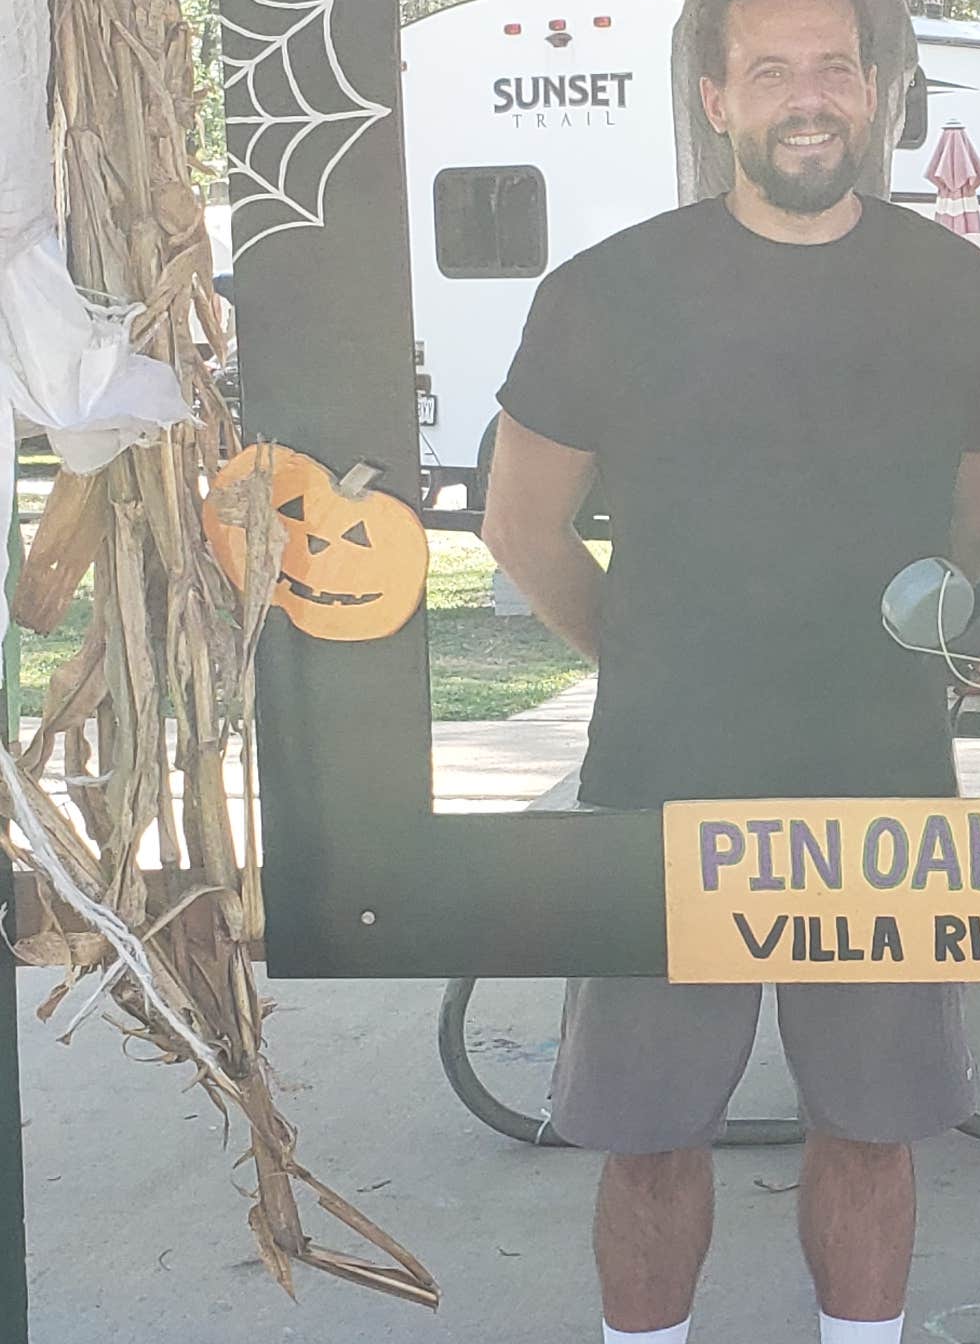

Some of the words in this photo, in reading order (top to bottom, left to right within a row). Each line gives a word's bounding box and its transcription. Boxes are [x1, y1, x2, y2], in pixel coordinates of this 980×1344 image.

[493, 72, 633, 113] SUNSET
[512, 111, 616, 128] TRAIL
[700, 819, 842, 891] PIN
[733, 913, 904, 962] VILLA
